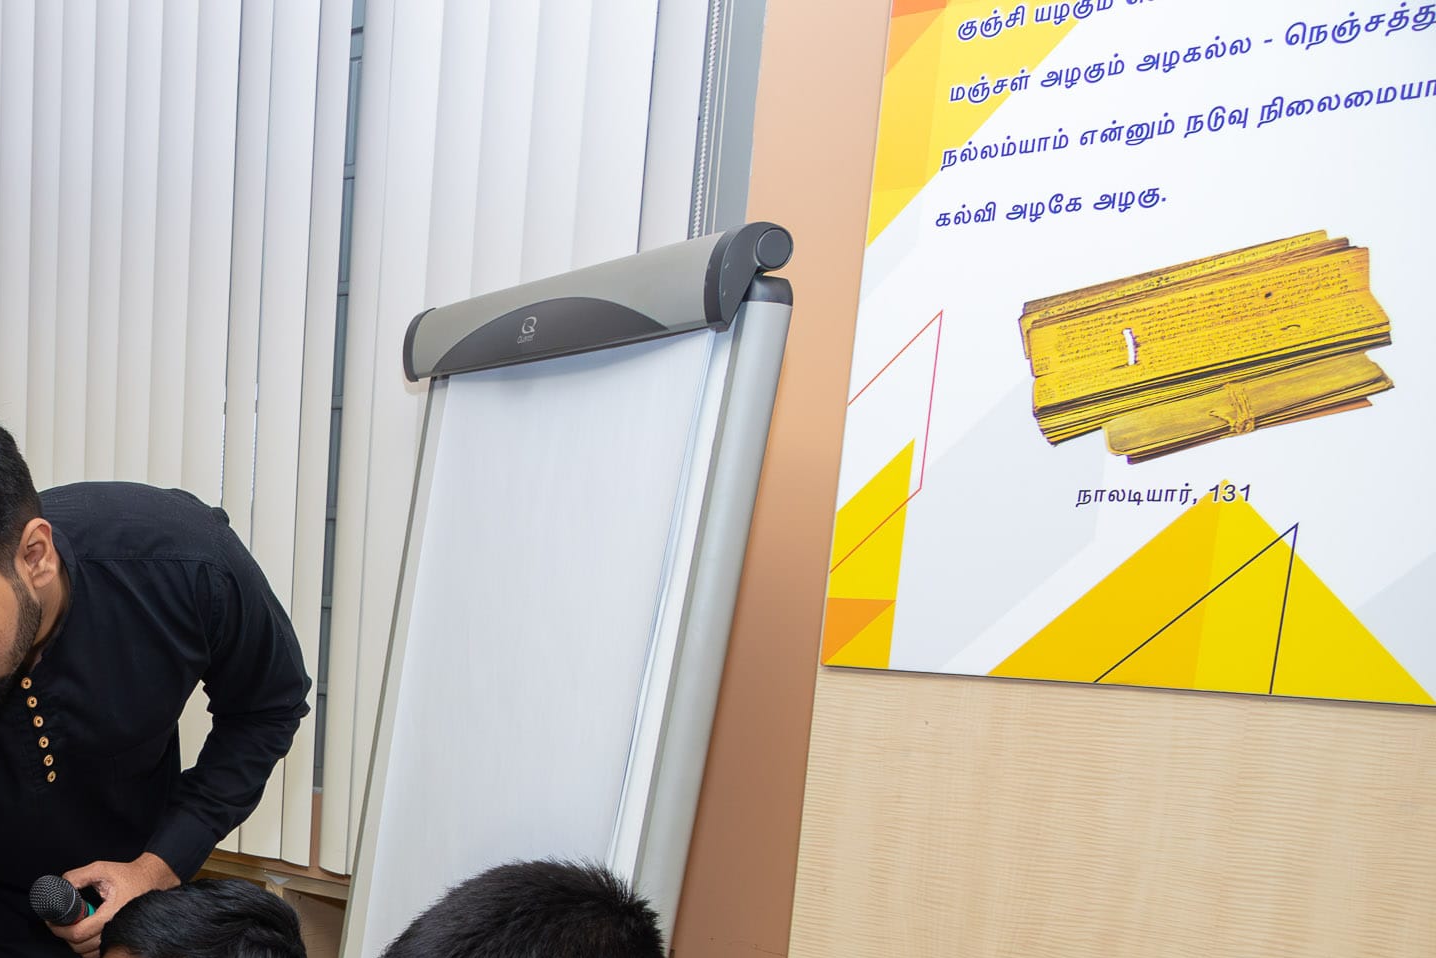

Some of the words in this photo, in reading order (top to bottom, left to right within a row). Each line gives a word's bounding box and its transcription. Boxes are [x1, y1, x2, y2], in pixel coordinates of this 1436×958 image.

[958, 6, 1025, 40] குஞ்சி
[950, 69, 1031, 103] மஞ்சள்
[1040, 53, 1125, 88] அழகும்
[1136, 35, 1252, 73] அழகல்ல
[940, 128, 1069, 171] நல்லம்யாம்
[1080, 112, 1176, 146] என்னும்
[1184, 106, 1249, 138] நடுவு
[935, 201, 997, 227] கல்வி
[1006, 193, 1082, 222] அழகே
[1208, 484, 1251, 502] 131
